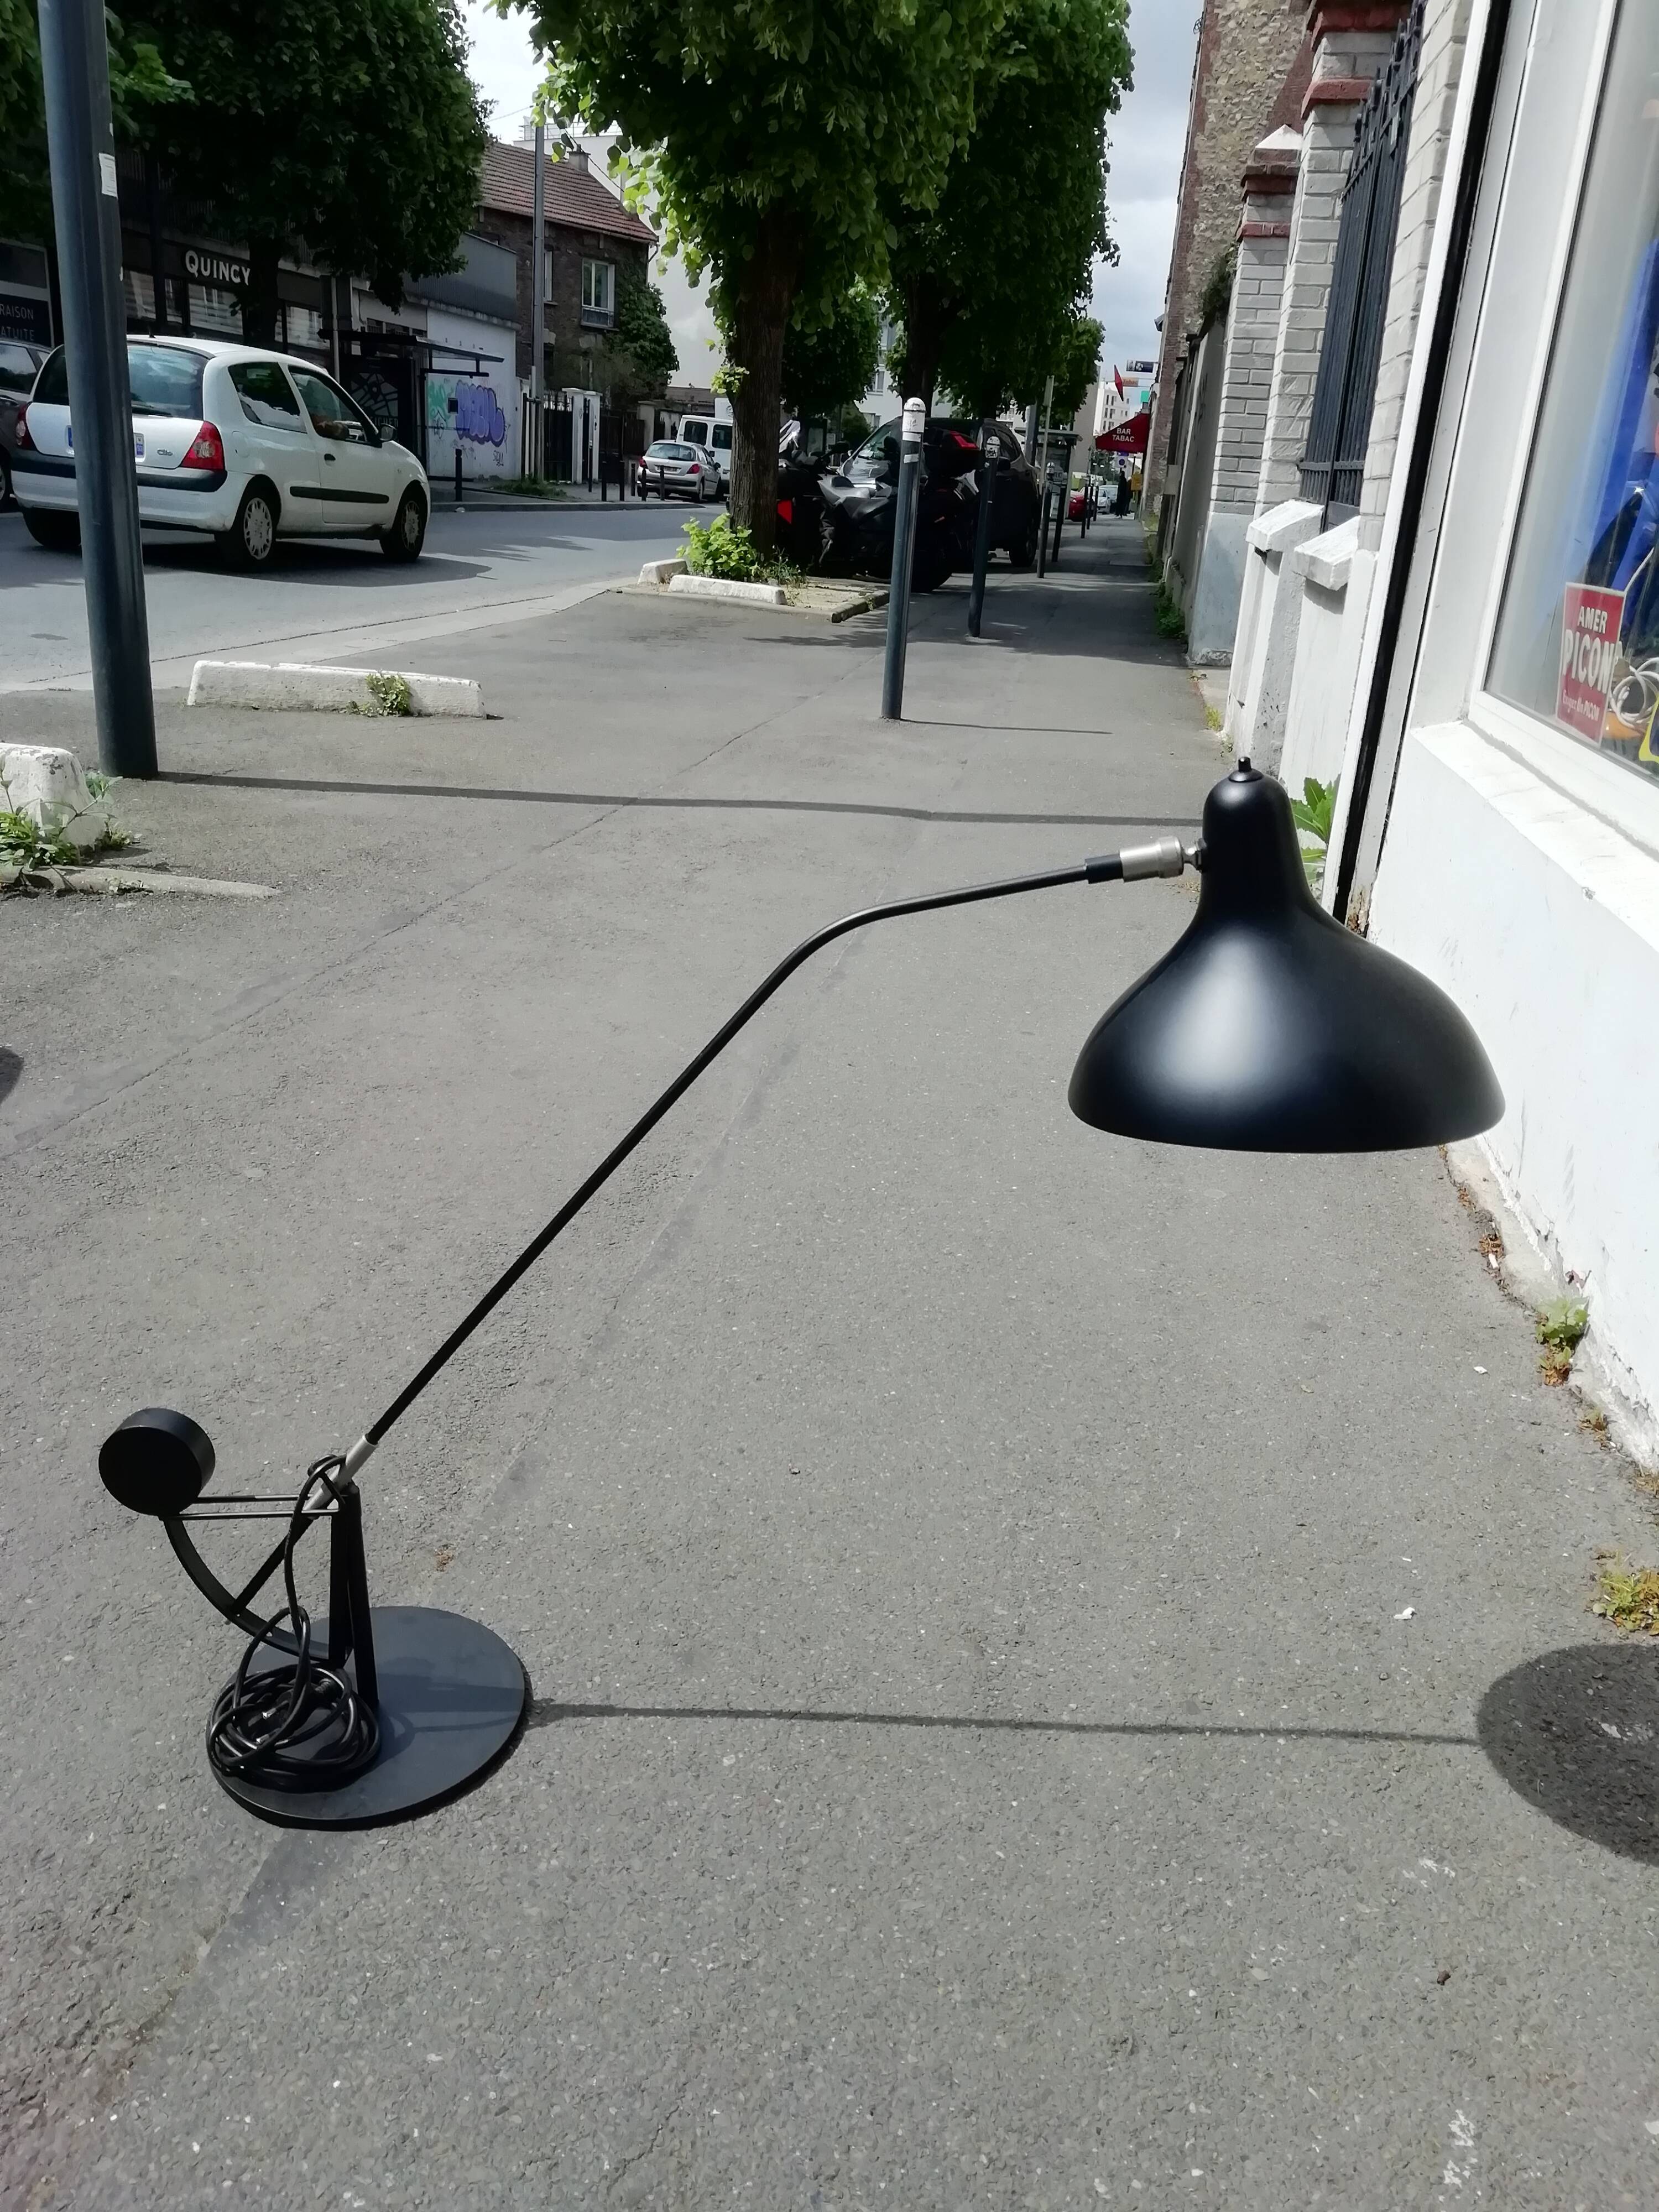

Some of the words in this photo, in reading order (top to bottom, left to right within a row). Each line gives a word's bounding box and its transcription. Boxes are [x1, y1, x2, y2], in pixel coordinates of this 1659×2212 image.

[185, 250, 251, 286] QUINCY
[1577, 606, 1608, 634] AMER
[1562, 629, 1615, 694] PICON
[1583, 700, 1600, 722] PICON
